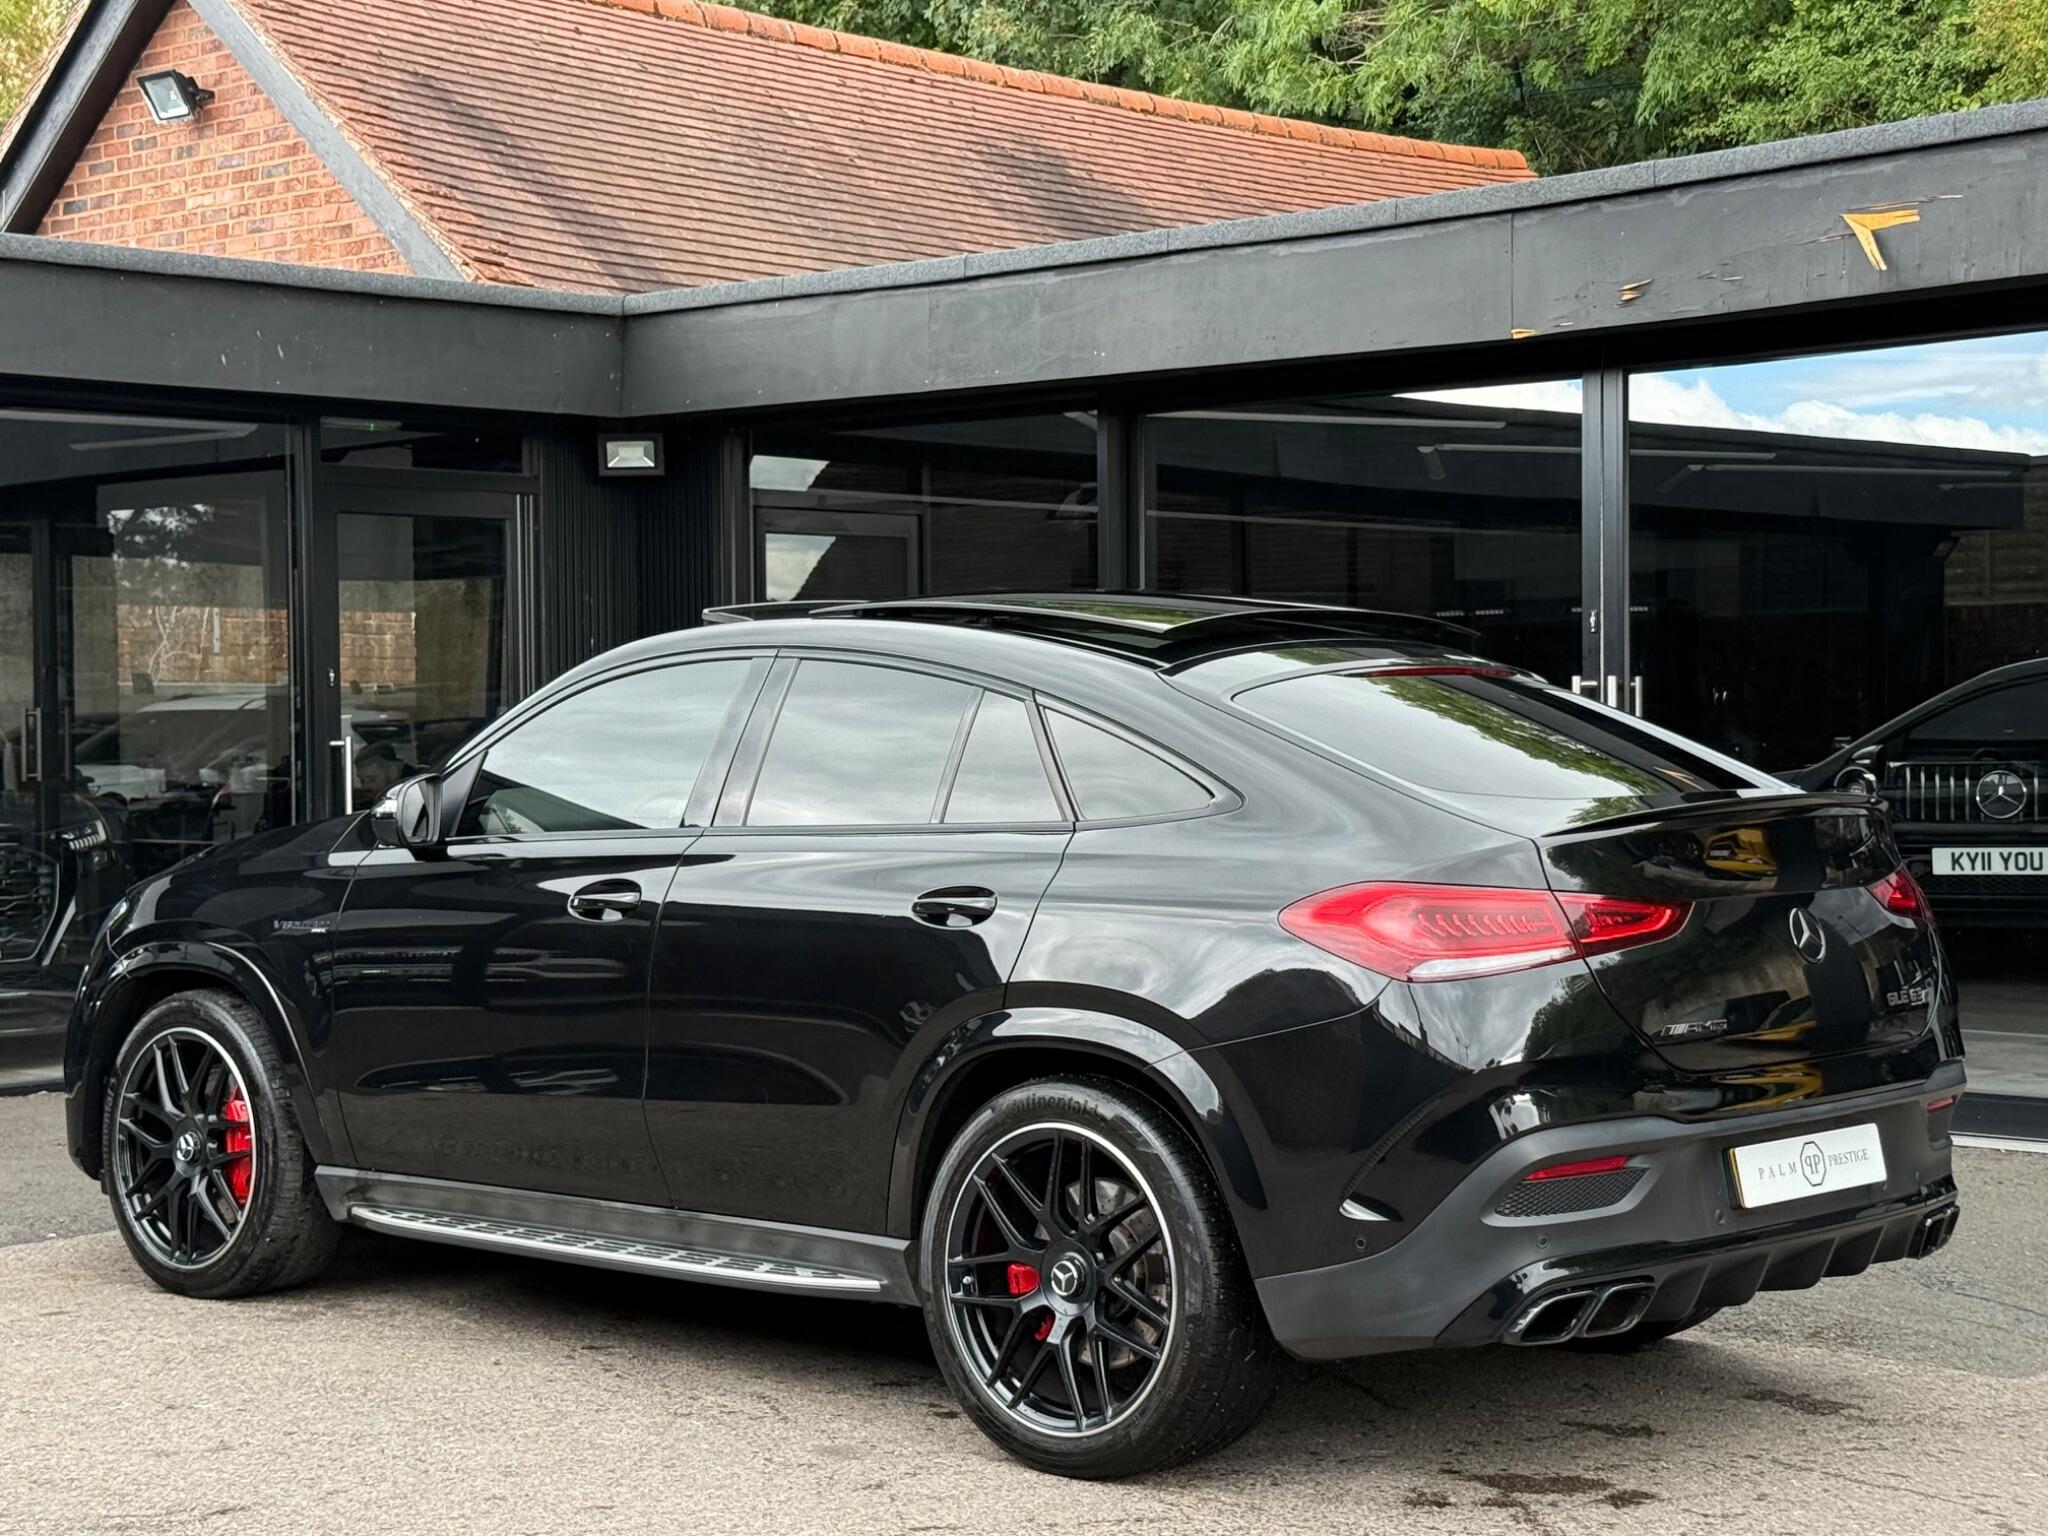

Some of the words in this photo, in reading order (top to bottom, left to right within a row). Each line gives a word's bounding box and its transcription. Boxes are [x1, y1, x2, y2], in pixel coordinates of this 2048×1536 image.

[1951, 852, 1992, 872] KY11
[1999, 852, 2043, 872] YOU
[1758, 1161, 1797, 1180] PALM
[1828, 1148, 1870, 1168] PRESTIGE
